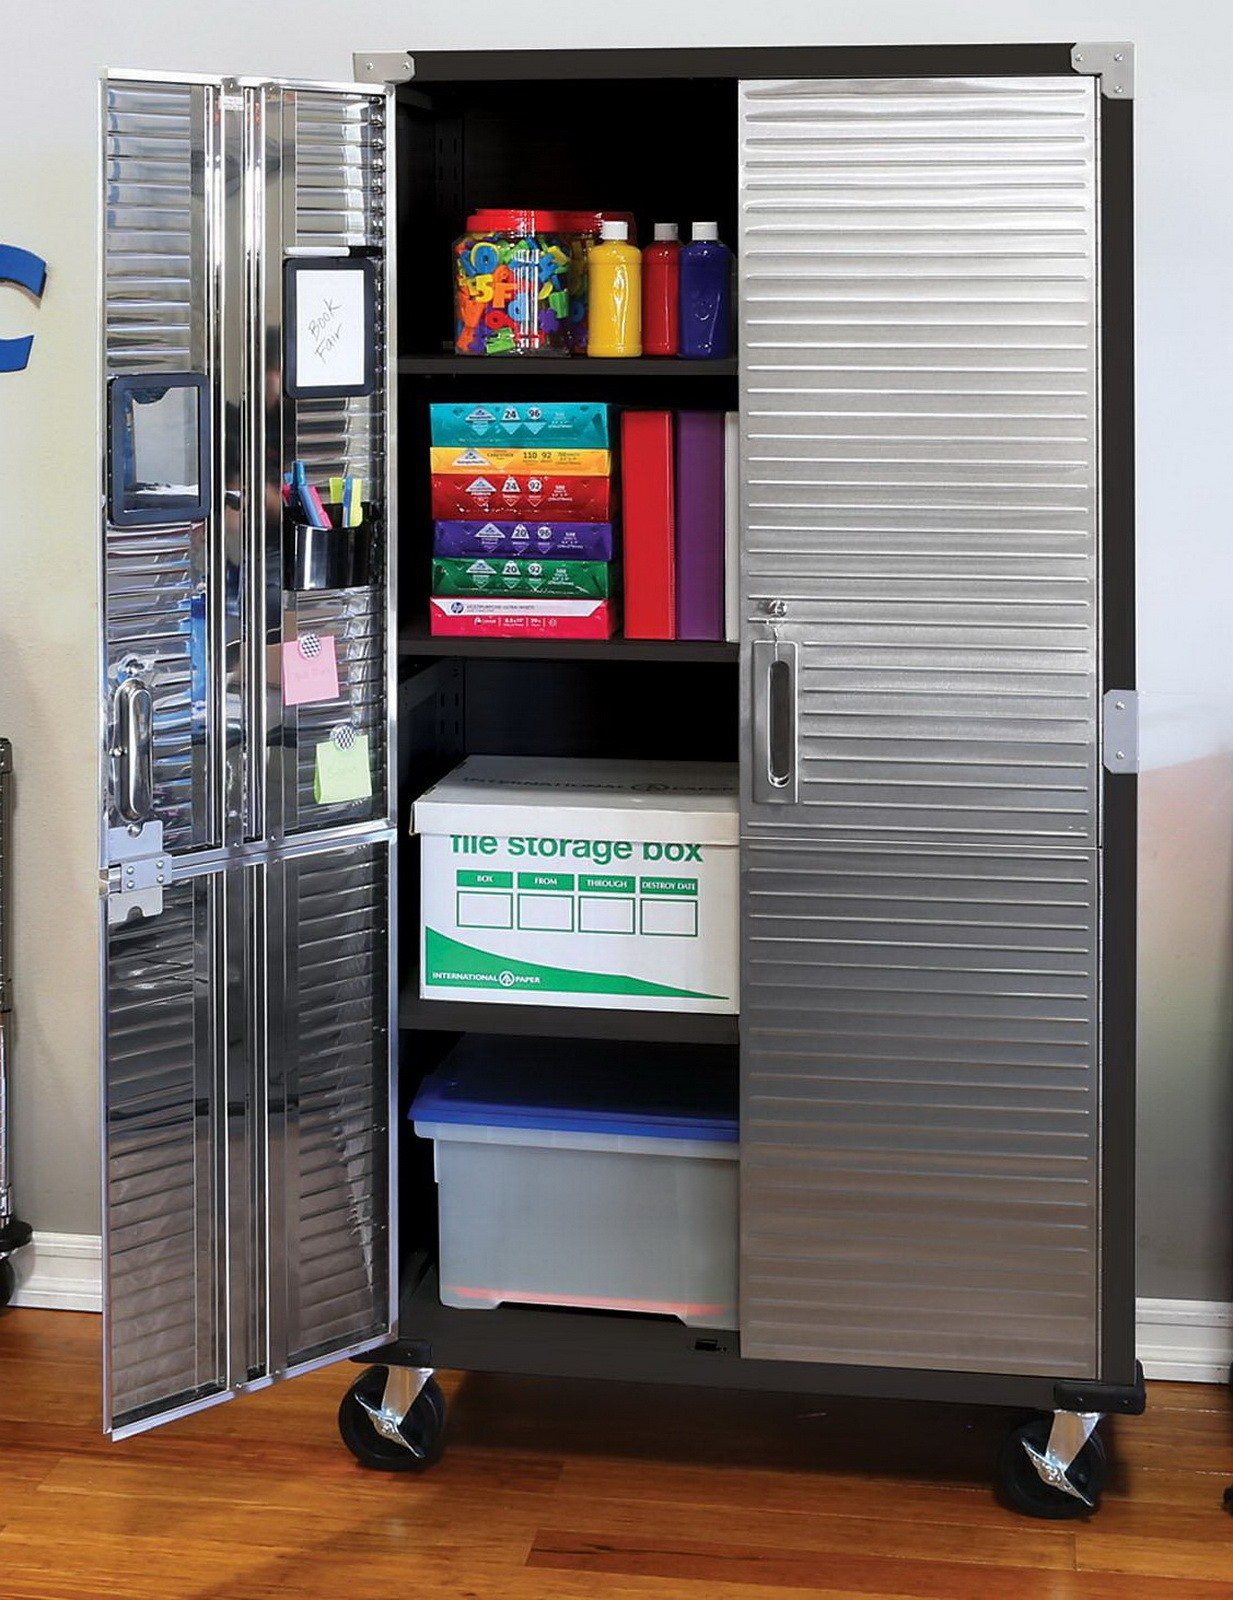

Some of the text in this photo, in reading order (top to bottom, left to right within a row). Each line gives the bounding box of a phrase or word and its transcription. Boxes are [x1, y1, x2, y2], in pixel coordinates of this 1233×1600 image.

[307, 299, 343, 341] Book
[314, 323, 343, 364] Fair
[504, 410, 540, 419] 24 96
[523, 451, 538, 459] 110
[541, 451, 552, 459] 92
[505, 481, 517, 490] 24
[529, 481, 540, 490] 92
[515, 528, 527, 537] 20
[539, 529, 550, 537] 96
[505, 565, 517, 574] 20
[529, 565, 540, 574] 92
[450, 834, 704, 866] file storage box
[476, 874, 494, 883] BOX
[534, 876, 558, 886] FROM
[586, 878, 628, 889] THROUGH
[642, 880, 697, 891] DESTROY DATE
[432, 971, 541, 984] INTERNATIONAL PAPER
